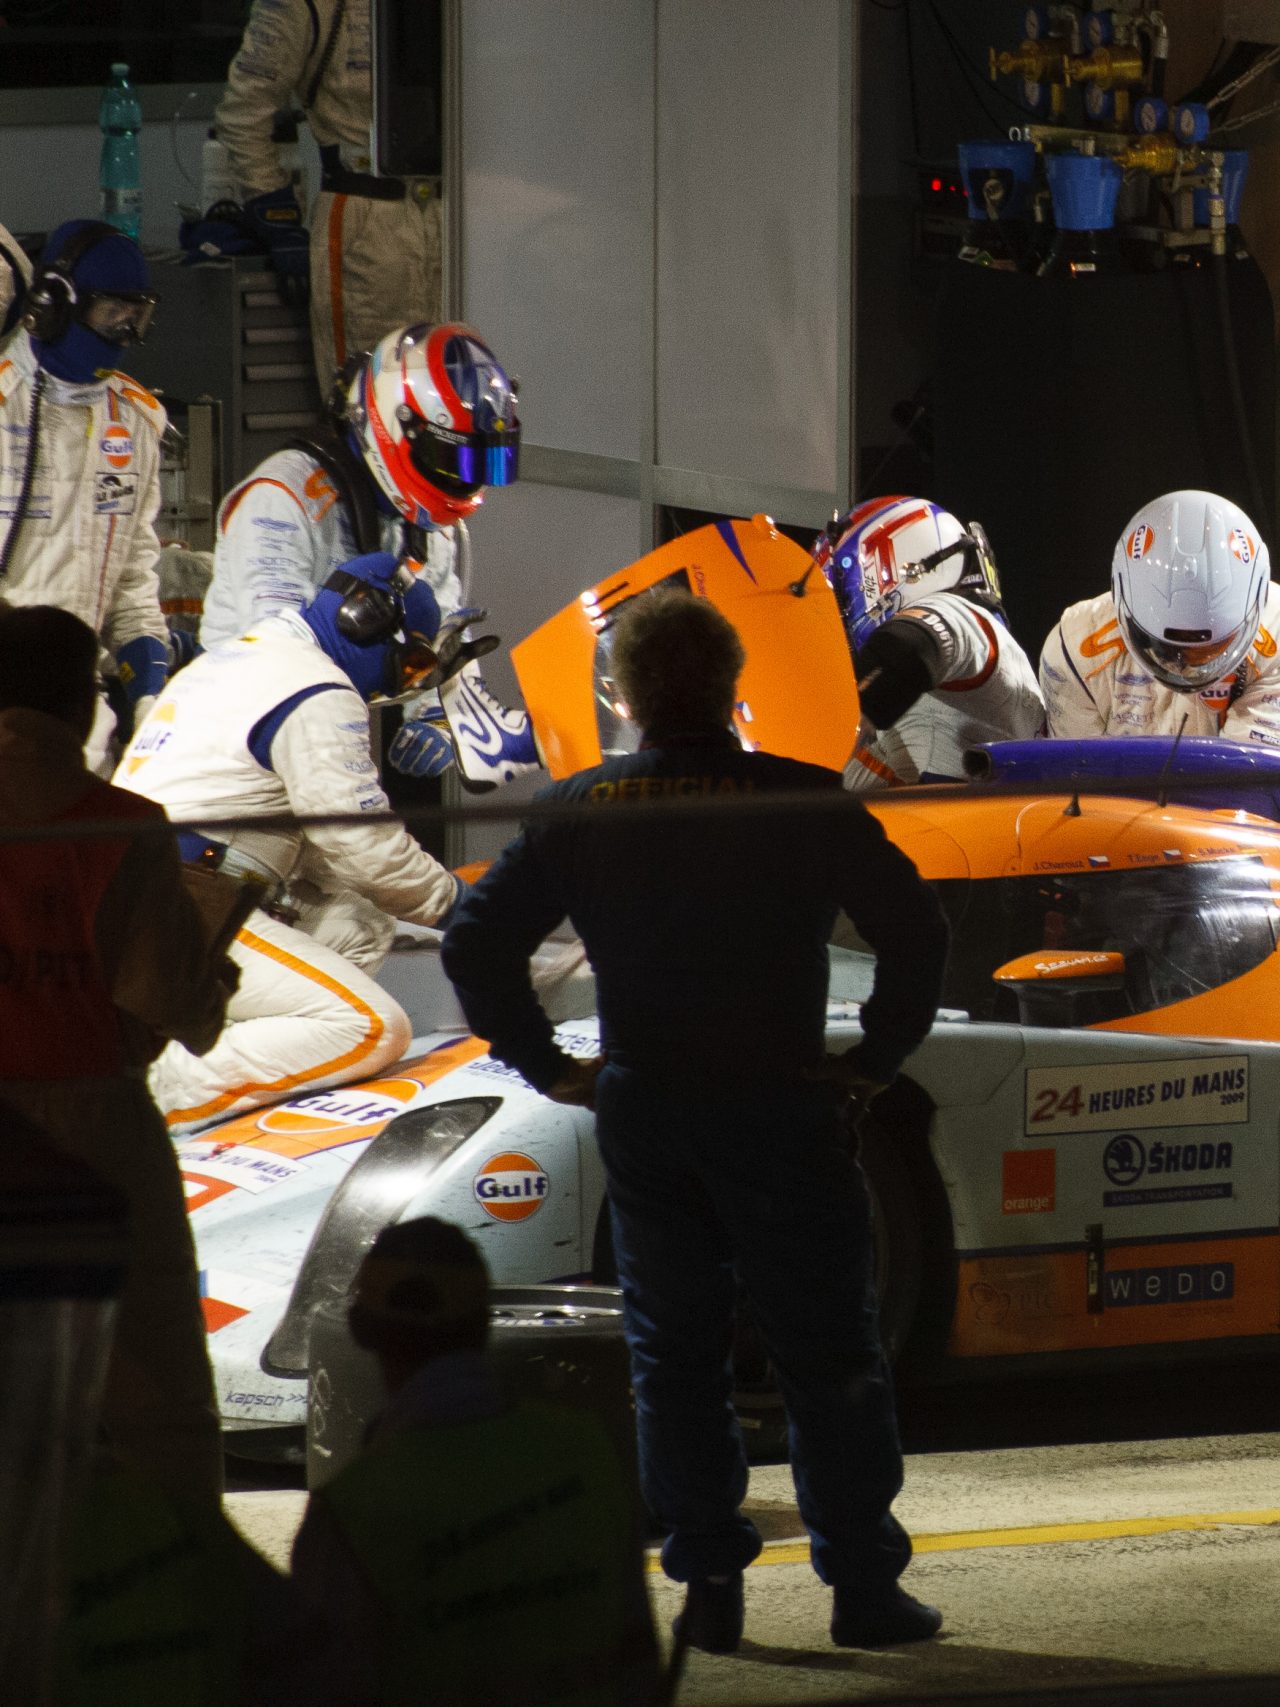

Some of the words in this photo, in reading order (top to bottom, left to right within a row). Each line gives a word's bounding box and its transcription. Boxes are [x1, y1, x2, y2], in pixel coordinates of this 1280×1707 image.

[1133, 524, 1147, 560] Gulf
[284, 1091, 399, 1122] Gulf
[1030, 1085, 1085, 1124] 24
[1088, 1082, 1155, 1115] HEURES
[1160, 1077, 1186, 1102] DU
[1191, 1067, 1246, 1098] MANS
[1220, 1092, 1245, 1106] 2009
[1148, 1141, 1233, 1174] ŠKODA
[476, 1176, 547, 1198] Gulf
[1004, 1198, 1049, 1212] orange
